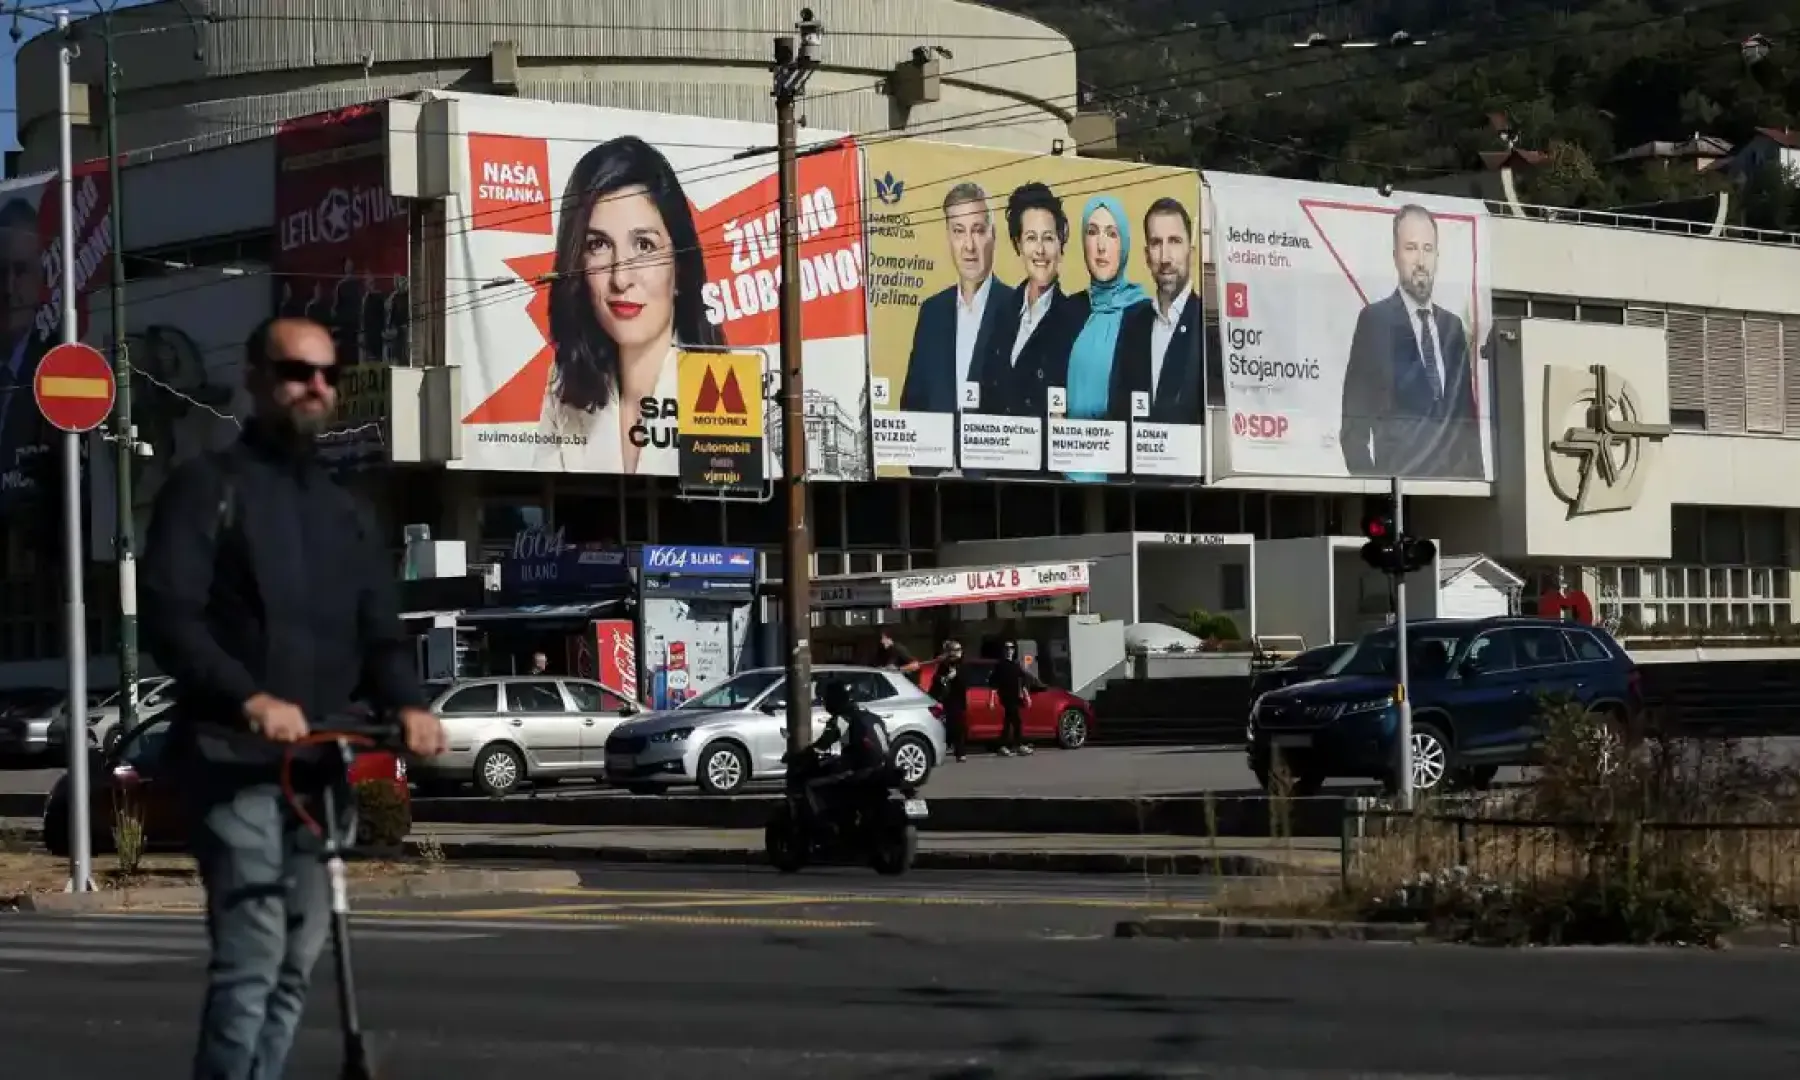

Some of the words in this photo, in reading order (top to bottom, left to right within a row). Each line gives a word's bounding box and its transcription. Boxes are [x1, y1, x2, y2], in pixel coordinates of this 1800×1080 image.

[483, 160, 540, 187] NAŠA
[479, 185, 545, 204] STRANKA
[282, 207, 322, 250] LETU
[722, 185, 838, 274] ŽIVMO
[1226, 226, 1266, 245] Jedna
[701, 242, 863, 325] SLOBDNO!
[1234, 292, 1244, 309] 3
[1227, 321, 1263, 351] Igor
[1228, 352, 1320, 382] Stojanović
[966, 389, 977, 402] 2.
[1053, 394, 1064, 407] 2.
[1136, 398, 1147, 411] 3.
[693, 415, 748, 427] MOTOREX
[873, 419, 906, 430] DENIS
[1248, 413, 1289, 438] SDP
[1136, 428, 1169, 440] ADNAN
[648, 547, 690, 569] 1664
[690, 553, 723, 566] BLANC
[967, 571, 1005, 590] ULAZ
[1011, 569, 1020, 586] B
[1038, 570, 1066, 584] tehno
